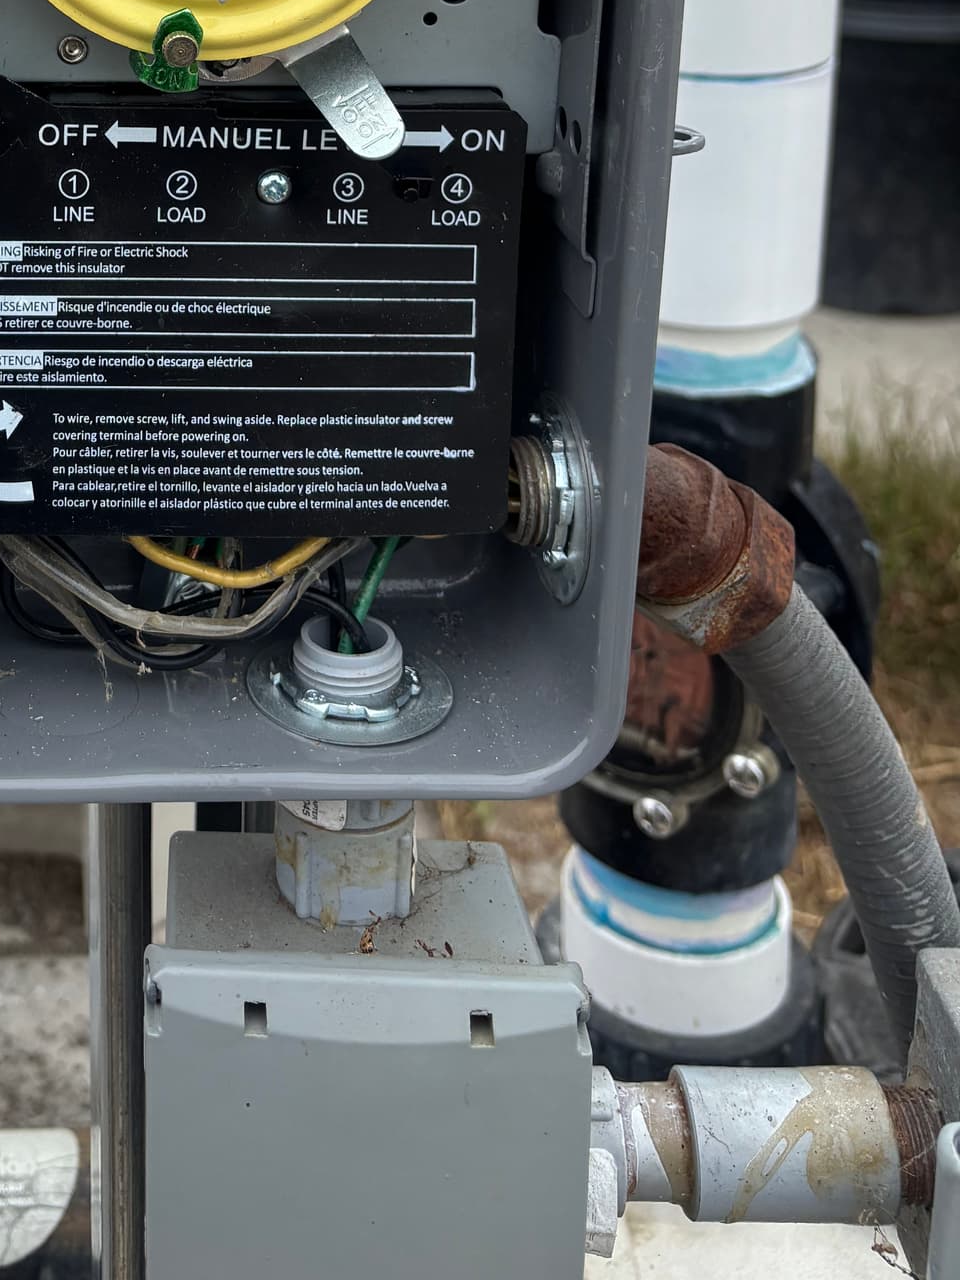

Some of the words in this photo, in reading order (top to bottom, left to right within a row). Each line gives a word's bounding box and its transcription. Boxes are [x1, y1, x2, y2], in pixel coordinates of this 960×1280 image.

[38, 124, 98, 146] OFF
[162, 125, 291, 150] MANUEL
[460, 129, 505, 152] ON
[53, 206, 94, 222] LINE
[157, 207, 206, 222] LOAD
[326, 209, 368, 225] LINE
[432, 210, 480, 226] LOAD
[24, 246, 61, 259] Risking
[64, 246, 75, 257] of
[78, 246, 97, 257] Fire
[100, 249, 112, 257] or
[115, 246, 154, 258] Electric
[156, 247, 188, 258] Shock
[12, 265, 53, 273] remove
[56, 262, 75, 273] this
[78, 262, 125, 273] insulator
[58, 302, 94, 315] Risque
[97, 302, 152, 312] d'incendie
[155, 304, 168, 312] ou
[172, 302, 185, 313] de
[188, 302, 213, 313] choc
[216, 302, 271, 316] électrique
[44, 356, 80, 368] Riesgo
[82, 356, 96, 366] de
[98, 356, 144, 366] incendio
[147, 358, 154, 366] o
[157, 356, 204, 369] descarga
[207, 356, 252, 368] eléctrica
[53, 430, 96, 442] covering
[100, 430, 142, 441] terminal
[146, 430, 179, 441] before
[182, 431, 230, 444] powering
[232, 433, 248, 442] on.
